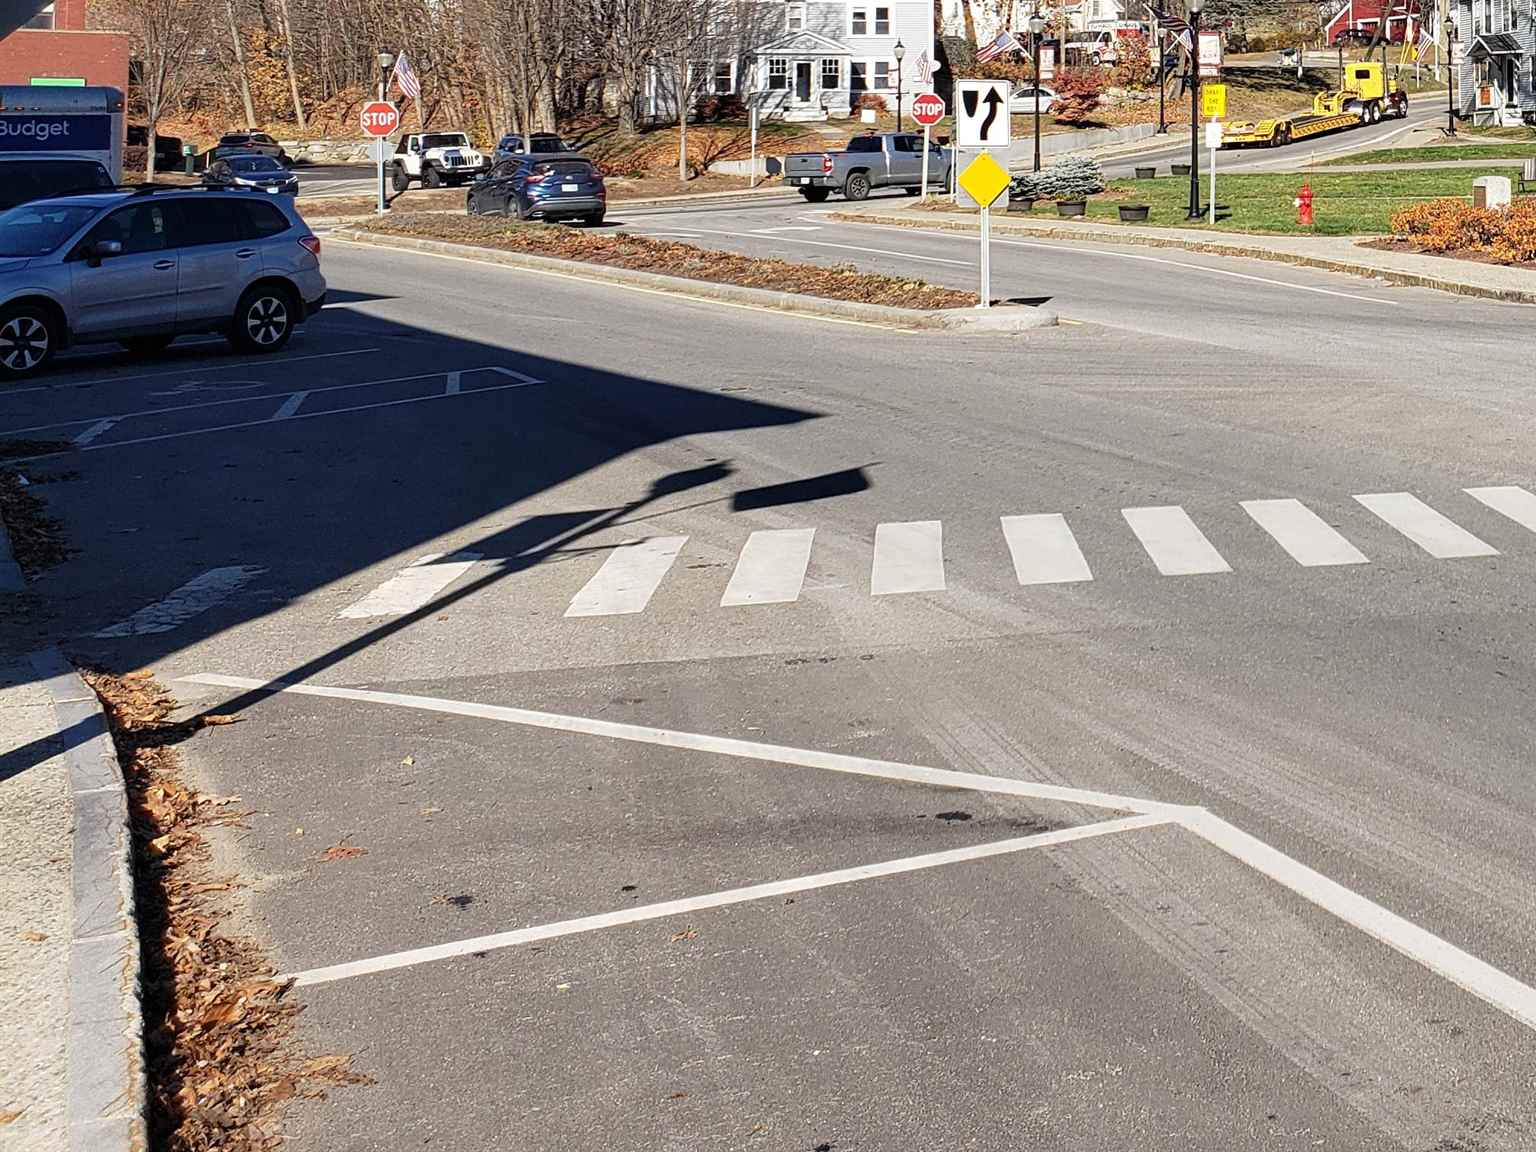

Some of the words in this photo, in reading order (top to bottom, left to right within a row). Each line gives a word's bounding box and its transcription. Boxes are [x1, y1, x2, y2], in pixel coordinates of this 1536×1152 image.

[914, 103, 943, 116] STOP
[363, 112, 396, 126] STOP
[0, 120, 70, 141] Budget
